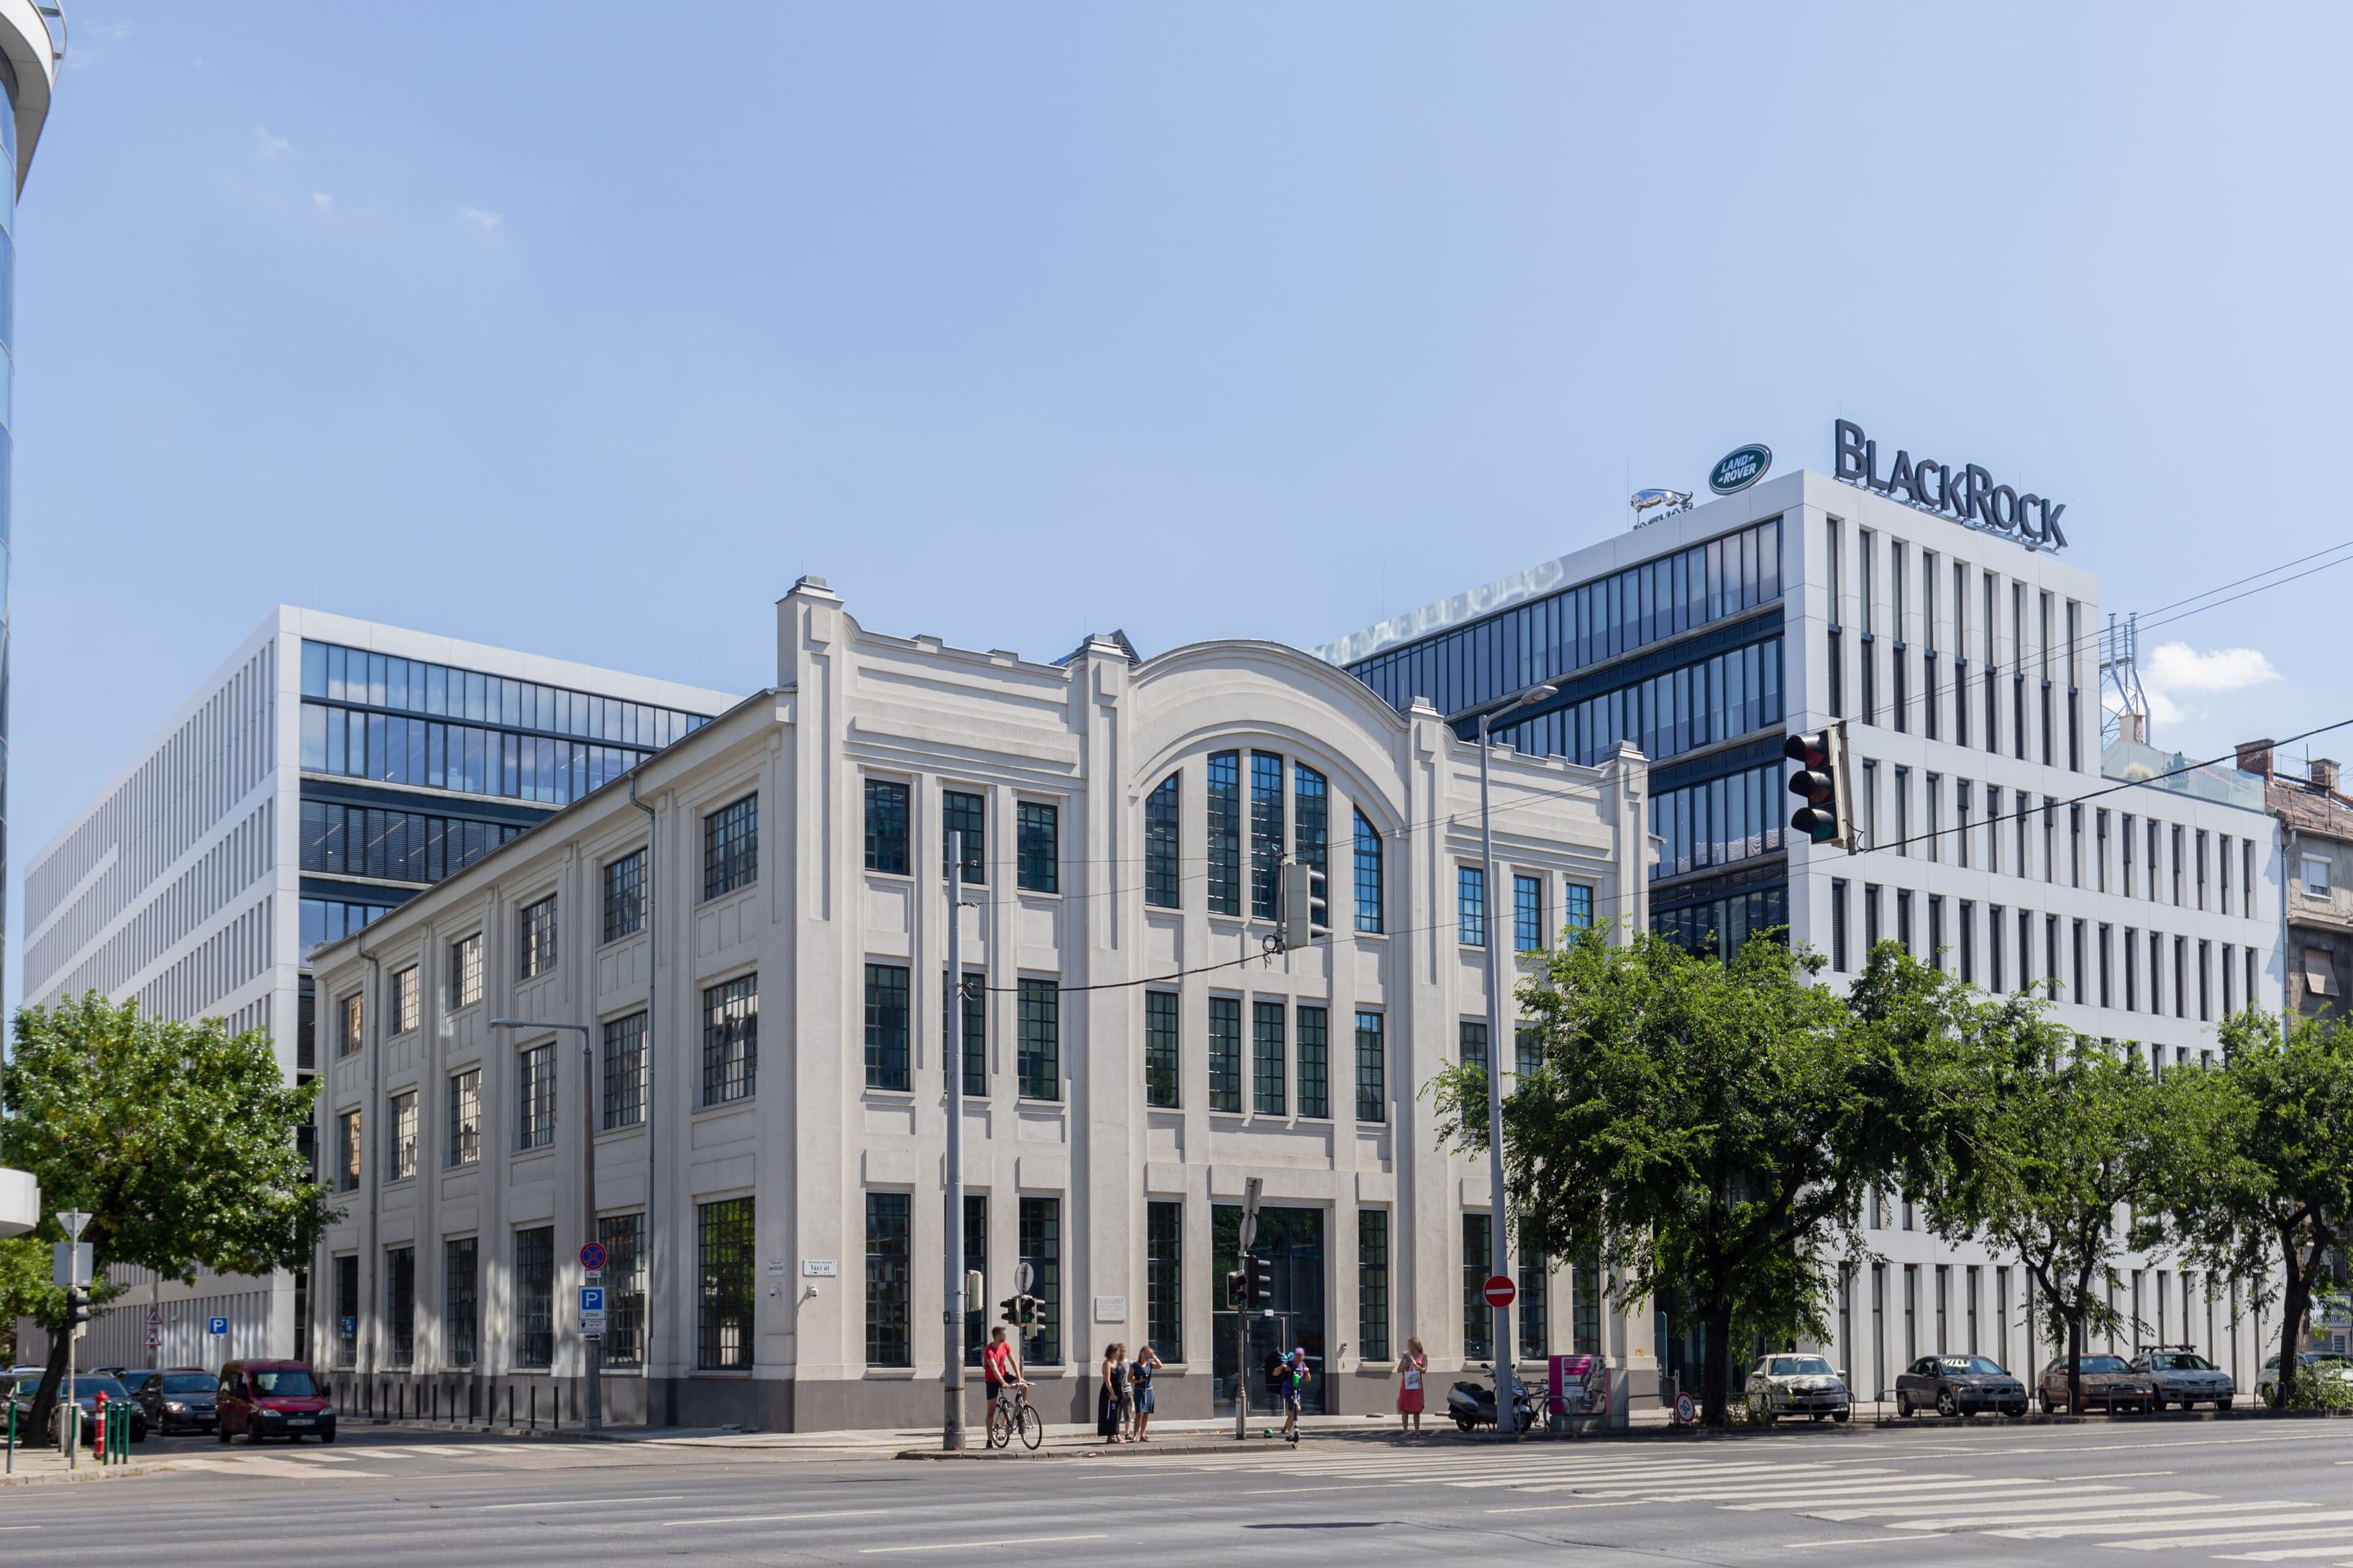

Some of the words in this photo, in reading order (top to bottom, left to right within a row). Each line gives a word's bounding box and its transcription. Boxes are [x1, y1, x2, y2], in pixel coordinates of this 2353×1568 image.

[1721, 454, 1749, 473] LAND
[1723, 462, 1757, 484] ROVER
[585, 1292, 598, 1307] P
[213, 1319, 224, 1332] P
[1680, 1400, 1690, 1415] 30
